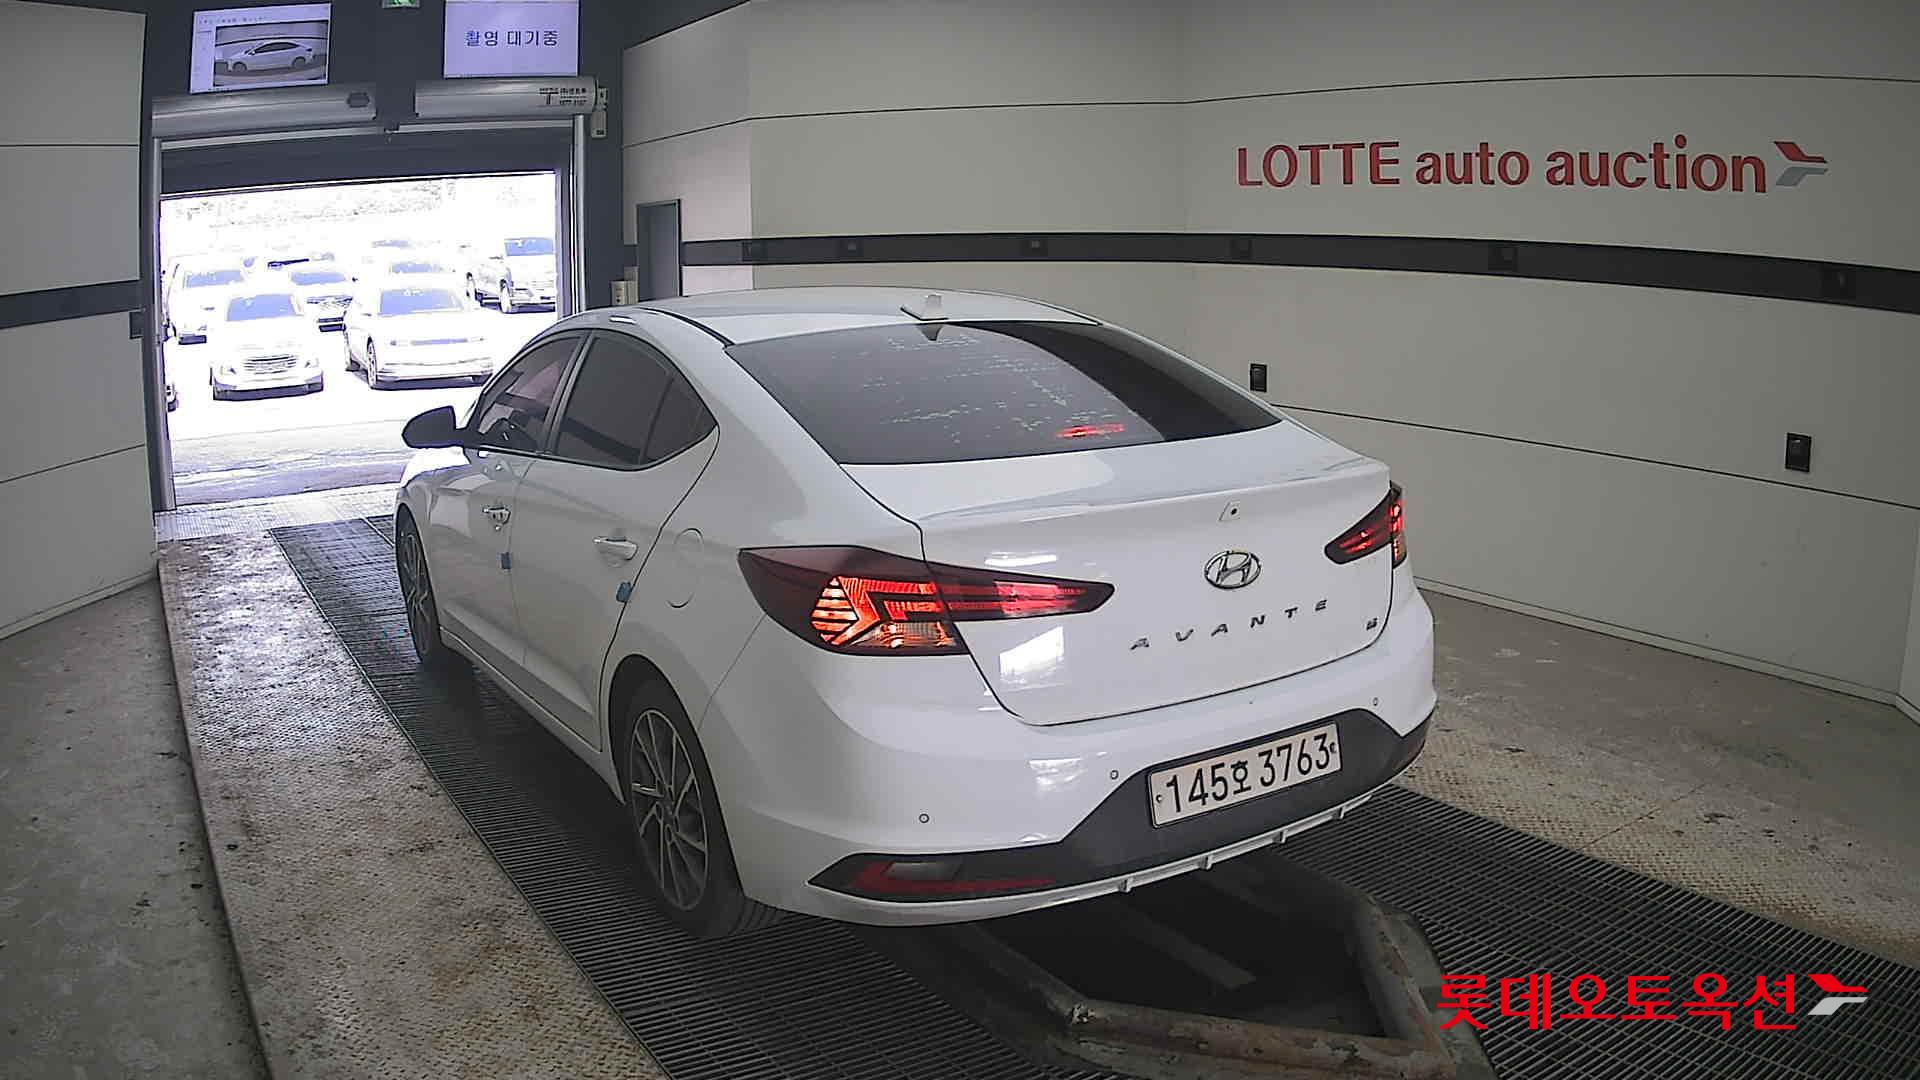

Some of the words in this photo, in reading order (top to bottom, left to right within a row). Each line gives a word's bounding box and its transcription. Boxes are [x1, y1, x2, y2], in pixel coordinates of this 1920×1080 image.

[507, 30, 559, 47] 대기중
[1237, 141, 1400, 188] LOTTE
[1415, 142, 1531, 186] auto
[1546, 134, 1767, 193] auction
[1130, 600, 1328, 650] AVANTE
